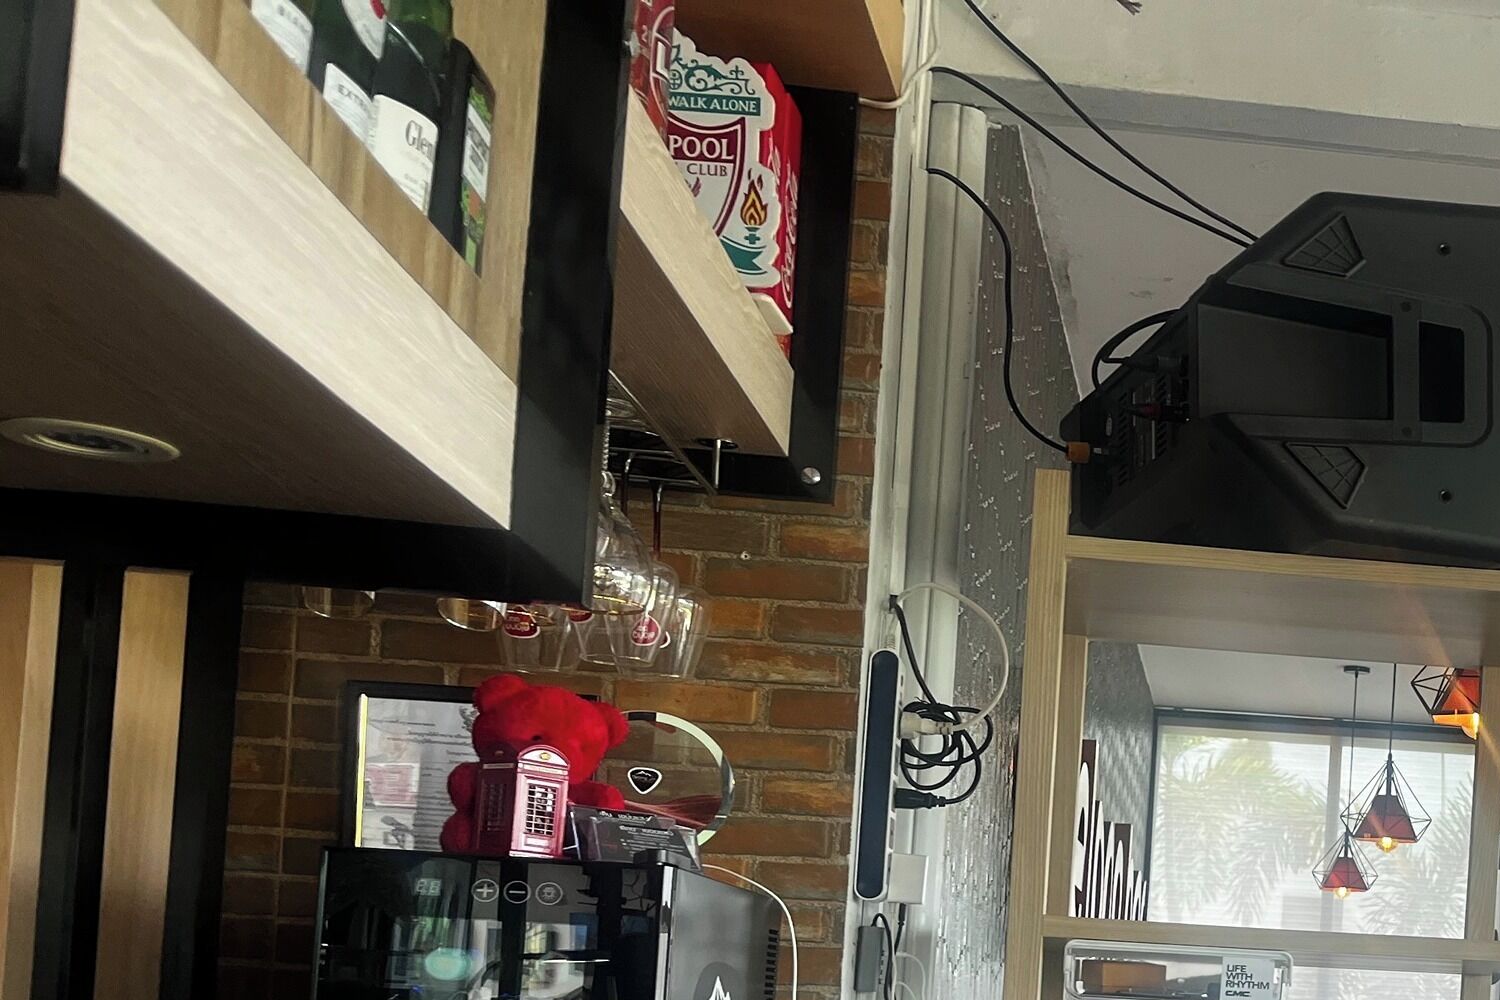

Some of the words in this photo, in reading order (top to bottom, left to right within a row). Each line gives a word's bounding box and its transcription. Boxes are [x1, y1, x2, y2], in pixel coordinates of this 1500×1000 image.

[668, 96, 710, 109] WALK
[710, 98, 758, 113] ALONE
[686, 162, 728, 178] CLUB
[1226, 964, 1247, 973] LIFE
[1226, 972, 1253, 981] WITH
[1225, 979, 1270, 990] RHYTHM
